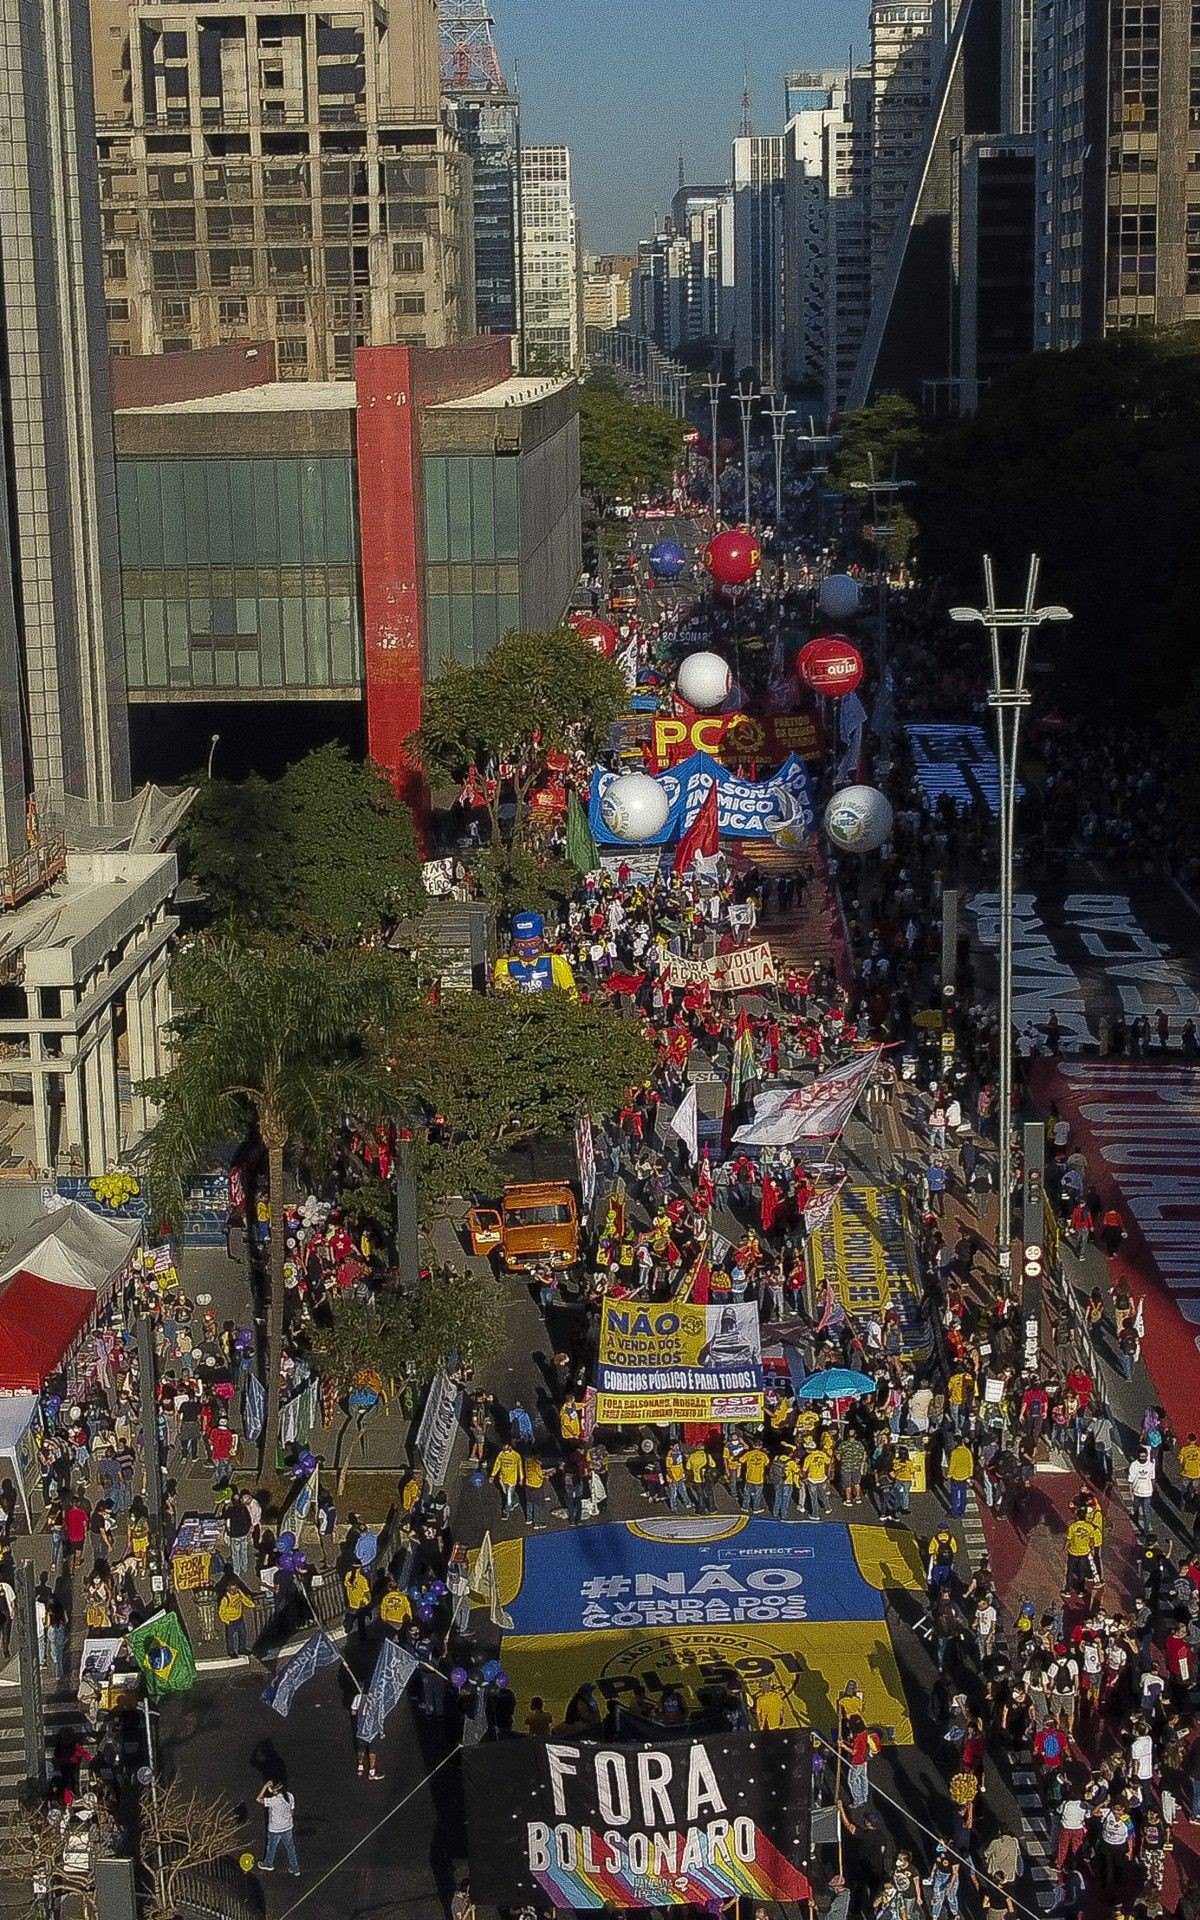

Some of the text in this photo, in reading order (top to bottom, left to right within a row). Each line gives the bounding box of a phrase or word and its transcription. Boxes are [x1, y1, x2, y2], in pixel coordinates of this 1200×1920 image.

[686, 789, 774, 813] INMIGO
[723, 947, 770, 970] VOLTA
[731, 963, 774, 986] LULA
[1028, 1248, 1040, 1256] 50
[607, 1307, 680, 1337] NÃO
[617, 1338, 655, 1351] VENDA
[659, 1338, 682, 1350] DOS
[607, 1350, 682, 1366] CORREIOS
[604, 1370, 648, 1391] CORREIOS
[650, 1370, 687, 1390] PÚBLICO
[688, 1370, 694, 1389] É
[694, 1373, 719, 1389] PARA
[603, 1399, 623, 1409] FORA
[713, 1397, 755, 1406] CSP
[581, 1564, 803, 1598] #NÃO
[614, 1598, 729, 1611] VENDA
[738, 1595, 807, 1607] DOS
[583, 1606, 807, 1628] CORREIOS
[676, 1635, 750, 1649] VENDA
[545, 1743, 728, 1826] FORA
[527, 1816, 756, 1875] BOLSONARO
